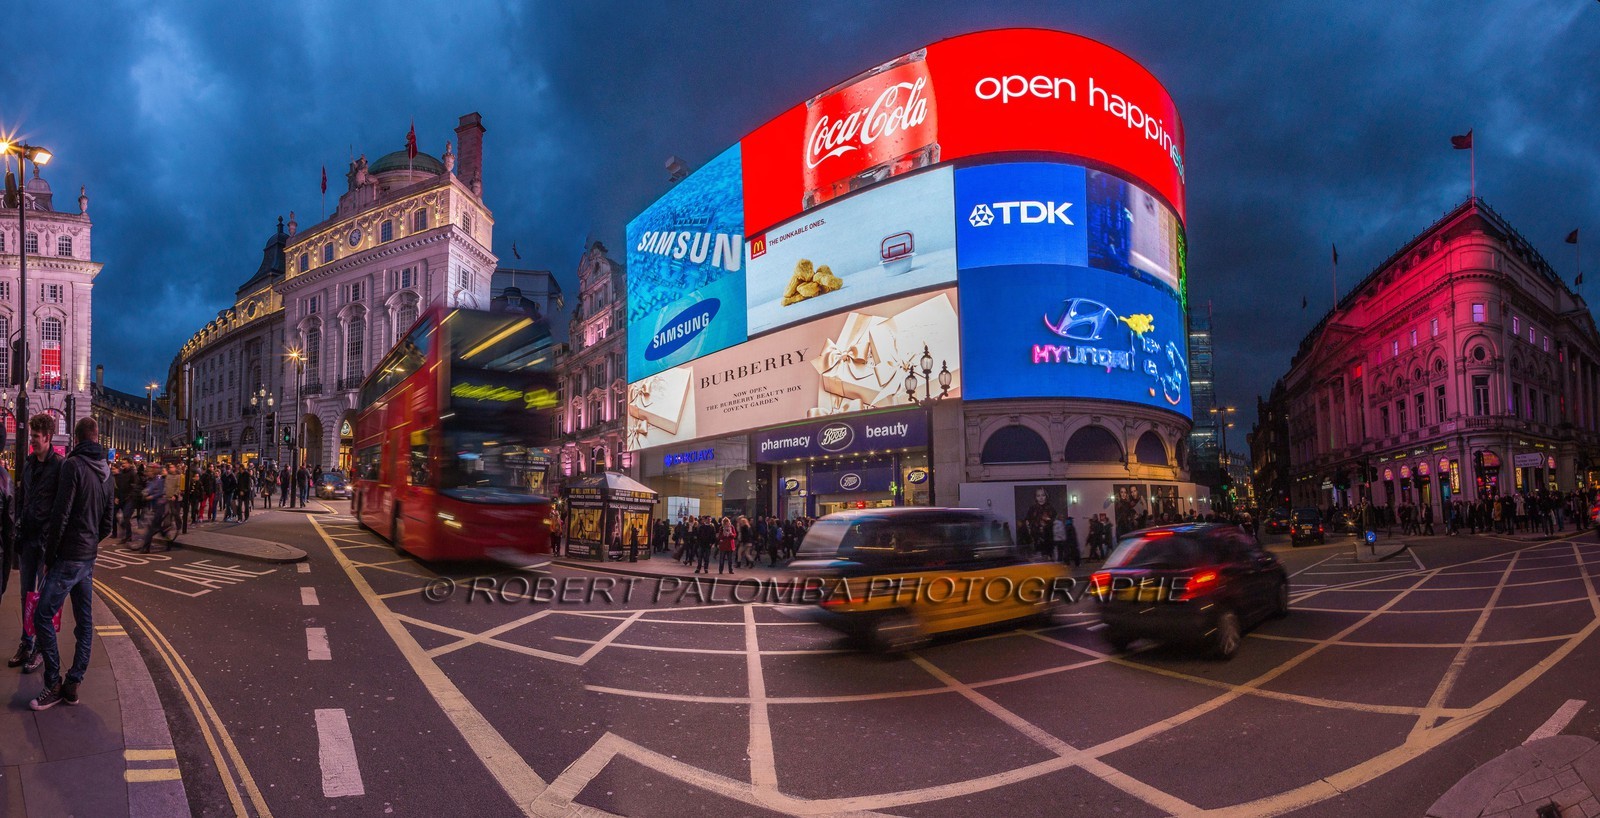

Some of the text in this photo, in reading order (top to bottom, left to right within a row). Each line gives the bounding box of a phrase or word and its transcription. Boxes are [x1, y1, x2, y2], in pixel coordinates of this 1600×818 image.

[974, 74, 1077, 104] open
[806, 75, 928, 169] Coca-Cola
[993, 200, 1074, 226] TDK
[768, 218, 827, 247] THE DUNKABLE ONES.
[652, 312, 710, 349] SAMSUNG
[700, 348, 809, 389] BURBERRY
[720, 396, 754, 409] BURBERRY
[756, 389, 784, 400] BEAUTY
[787, 385, 802, 393] BOX
[733, 386, 768, 398] NOW OPEN
[723, 397, 779, 413] COVENT GARDEN
[761, 434, 810, 452] pharmacy
[821, 427, 847, 446] Boots
[866, 422, 908, 439] beauty
[672, 448, 715, 465] BARCLAYS
[121, 559, 277, 598] LANE
